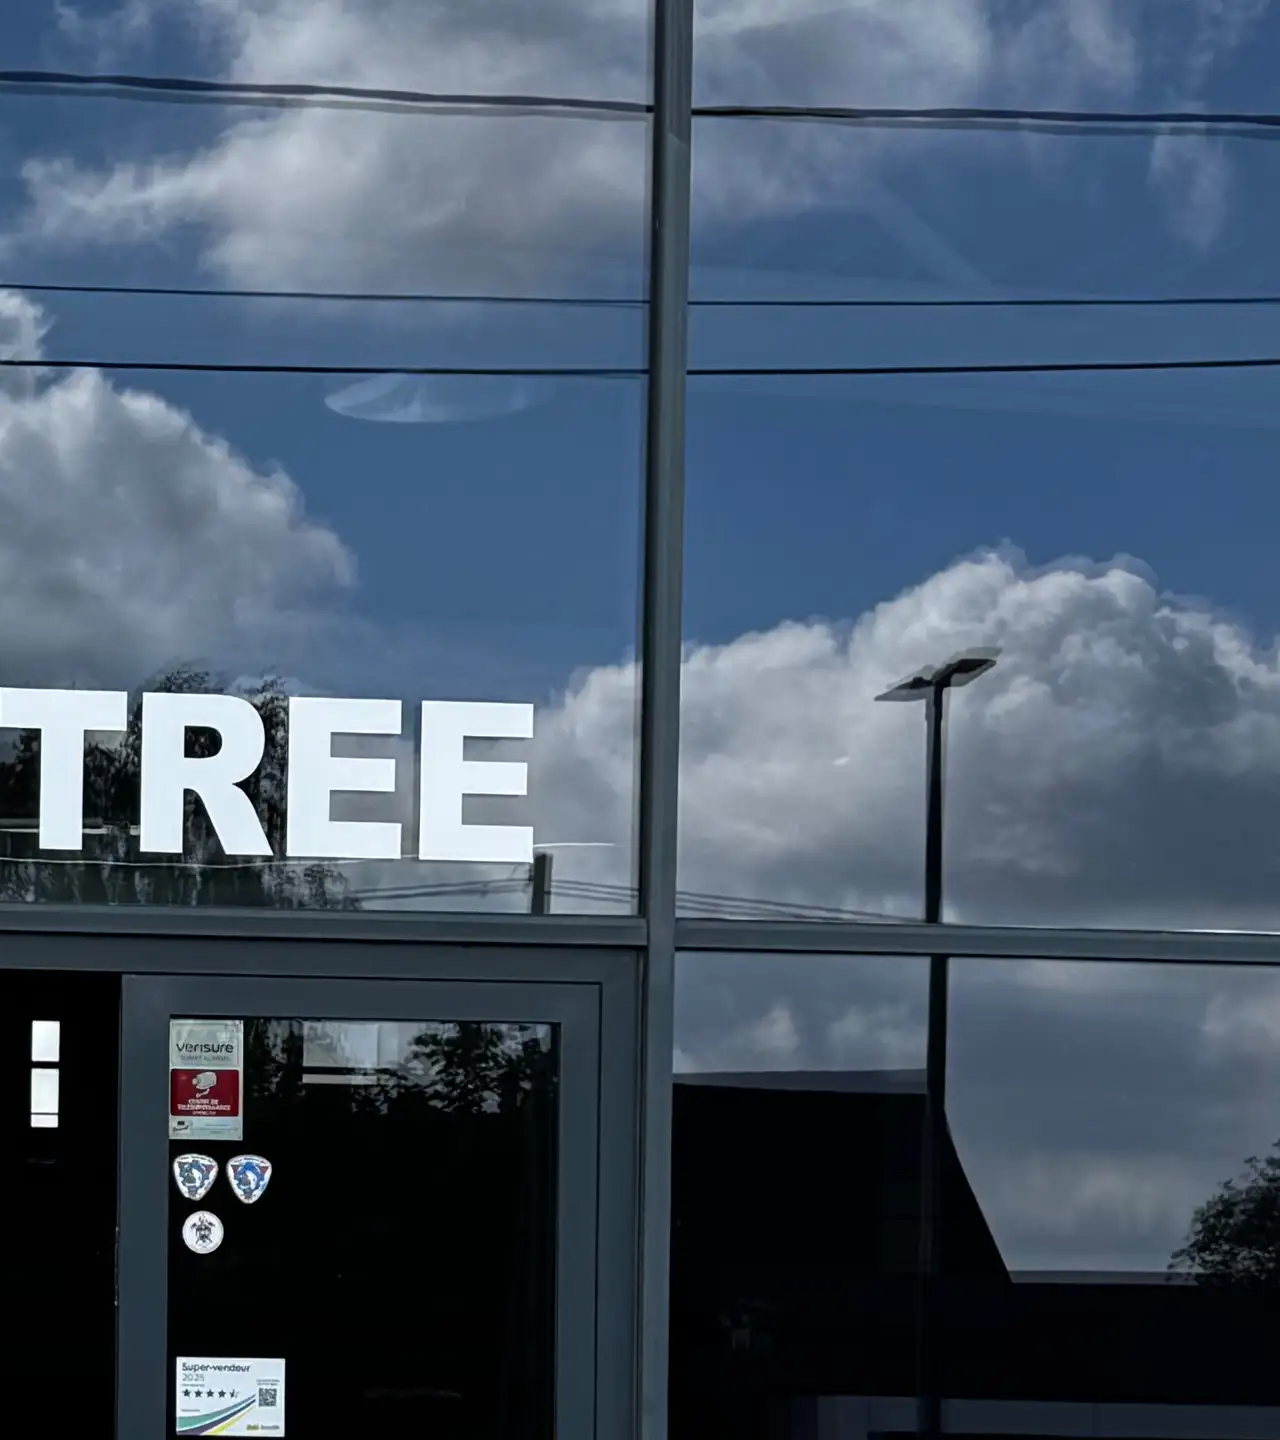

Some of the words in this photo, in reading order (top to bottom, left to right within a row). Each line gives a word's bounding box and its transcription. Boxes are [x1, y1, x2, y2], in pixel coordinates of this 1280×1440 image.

[176, 1042, 234, 1054] verisure
[182, 1362, 251, 1373] Super-vendeur
[182, 1373, 204, 1382] 2025
